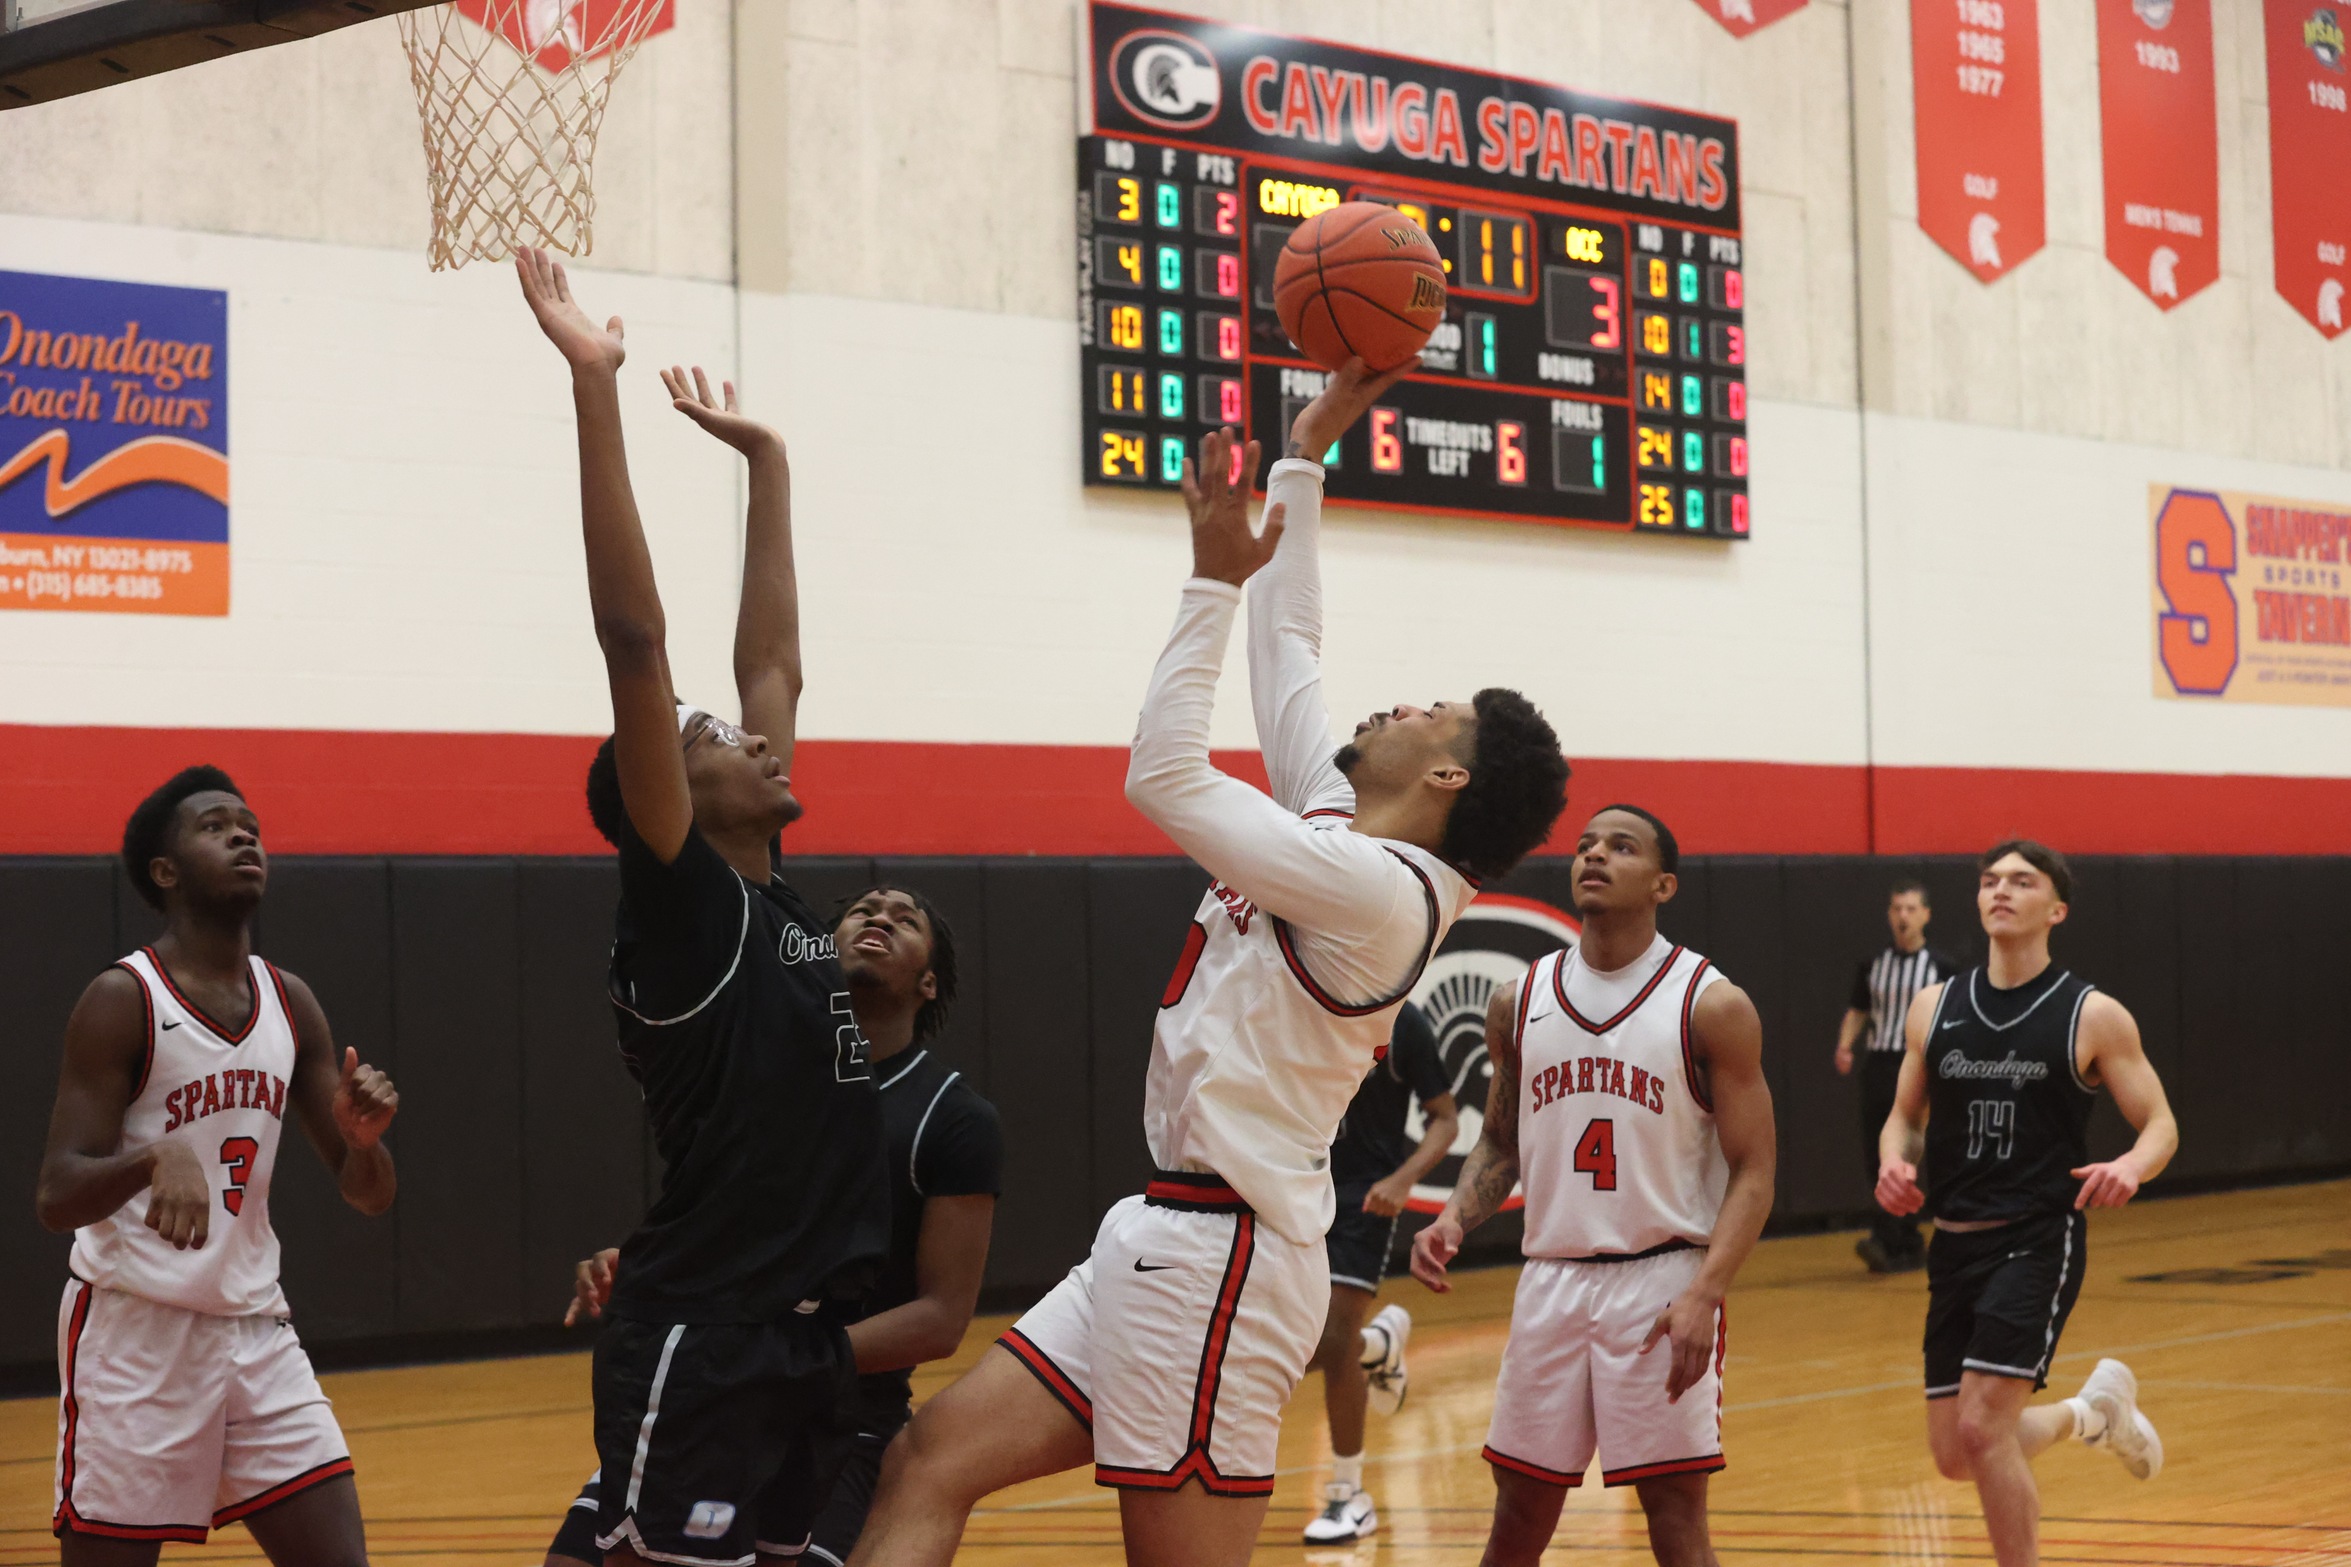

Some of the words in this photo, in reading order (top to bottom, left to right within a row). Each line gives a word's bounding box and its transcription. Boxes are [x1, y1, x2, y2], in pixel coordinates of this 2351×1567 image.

[1956, 65, 2004, 98] 1977
[1241, 56, 1469, 167] CAYUGA
[1477, 97, 1728, 211] SPARTANS
[1161, 148, 1177, 176] F
[1197, 153, 1235, 185] PTS
[1117, 178, 1140, 221] 3
[1157, 183, 1180, 228] 0
[1216, 191, 1238, 235] 2
[1260, 178, 1340, 219] CAYUGA
[1118, 245, 1142, 285] 4
[1158, 246, 1182, 290] 0
[1218, 254, 1240, 297] 0
[1679, 262, 1699, 303] 0
[1725, 269, 1744, 309] 0
[1111, 305, 1143, 350] 10
[1160, 309, 1183, 354] 0
[1219, 317, 1241, 360] 0
[1589, 276, 1621, 349] 3
[0, 311, 213, 391] Onondaga
[1482, 319, 1497, 375] 1
[1643, 314, 1671, 355] 10
[1688, 321, 1701, 359] 1
[1726, 325, 1746, 365] 3
[1538, 352, 1595, 385] BONUS
[112, 380, 211, 429] Tours
[1111, 370, 1144, 412] 11
[1161, 373, 1184, 418] 0
[1220, 380, 1242, 423] 0
[1551, 398, 1604, 430] FOULS
[1645, 372, 1672, 411] 14
[1682, 375, 1702, 415] 0
[1728, 381, 1747, 421] 0
[1102, 432, 1145, 477] 24
[1162, 436, 1185, 482] 0
[1373, 409, 1402, 471] 6
[1406, 416, 1493, 451] TIMEOUTS
[1498, 422, 1527, 483] 6
[1638, 426, 1673, 468] 24
[1684, 432, 1703, 472] 0
[1730, 437, 1748, 476] 0
[1427, 448, 1471, 477] LEFT
[1592, 436, 1606, 490] 1
[1639, 484, 1674, 526] 25
[1685, 489, 1705, 529] 0
[1731, 493, 1749, 533] 0
[53, 544, 87, 568] NY
[2156, 487, 2238, 695] S
[1531, 1056, 1665, 1115] SPARTANS
[1939, 1049, 2048, 1090] Onondaga
[1573, 1118, 1617, 1191] 4
[1967, 1100, 2015, 1159] 14
[220, 1136, 259, 1217] 3
